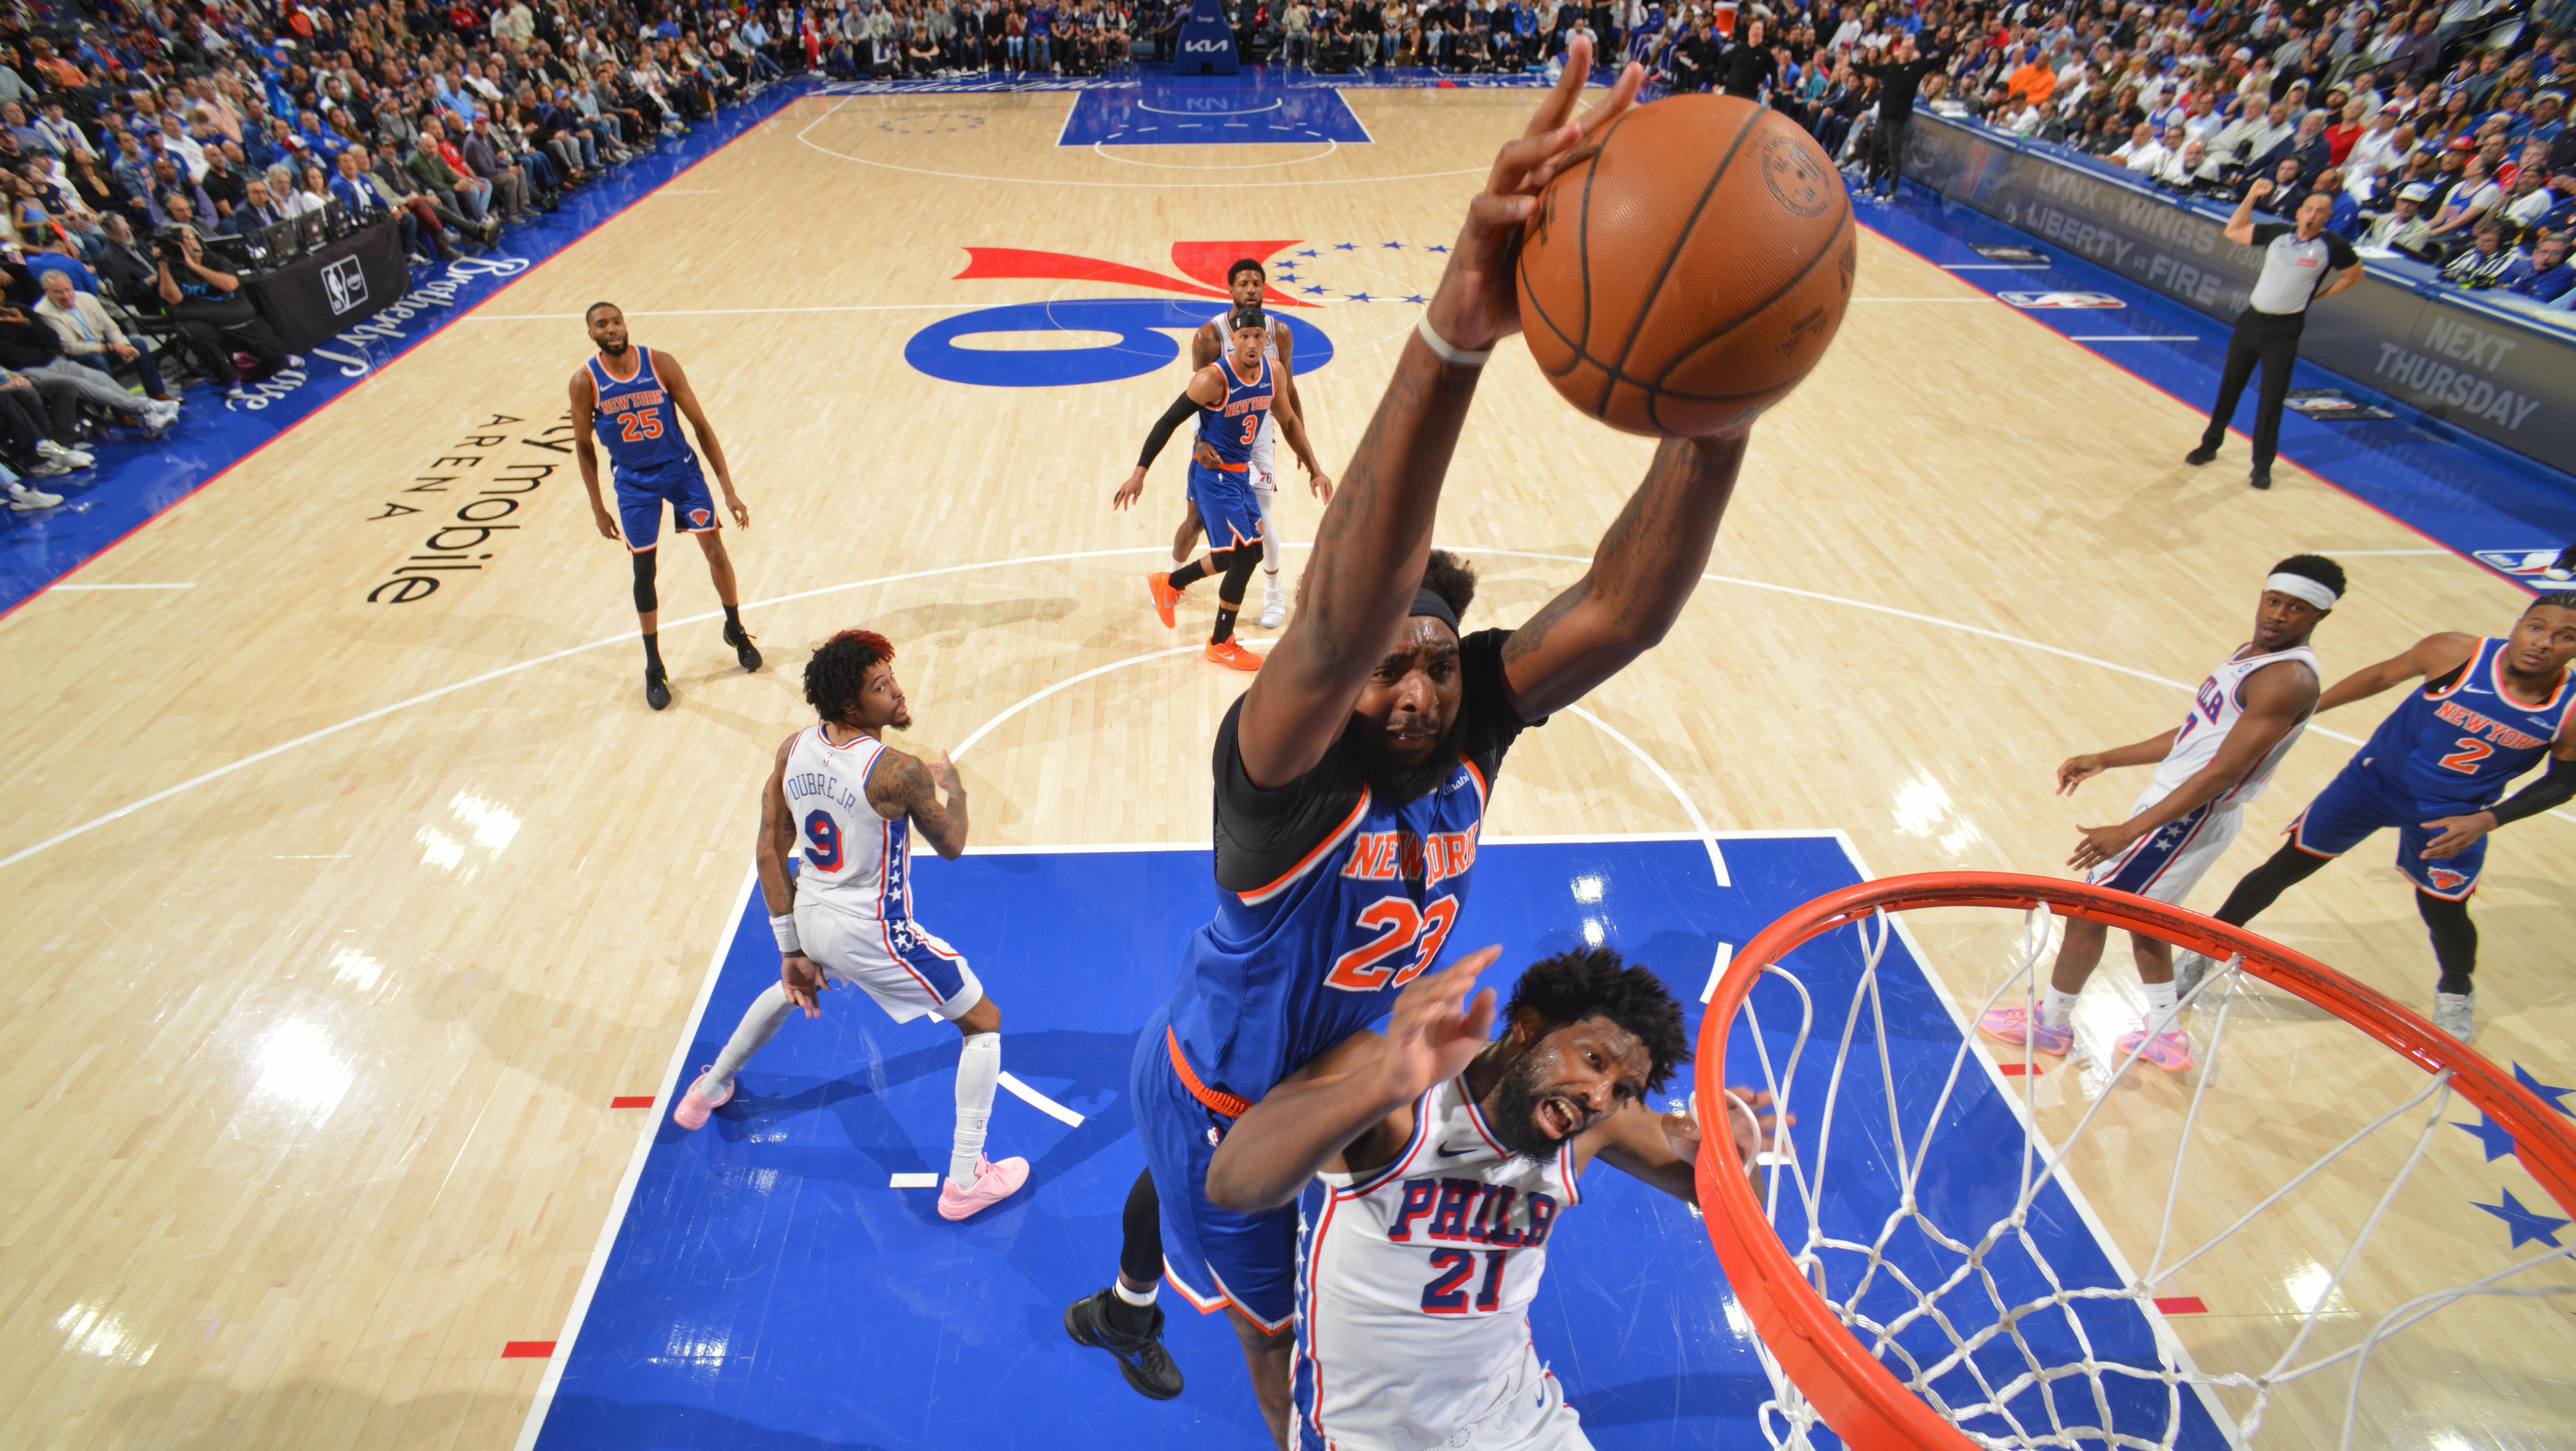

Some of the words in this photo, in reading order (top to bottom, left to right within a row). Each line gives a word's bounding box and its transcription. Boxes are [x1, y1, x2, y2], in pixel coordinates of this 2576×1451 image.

[2037, 165, 2102, 209] LYNX
[2119, 194, 2214, 255] WINGS
[2025, 201, 2134, 265] LIBERTY
[2146, 254, 2222, 307] FIRE
[2424, 316, 2518, 372] NEXT
[601, 396, 629, 415] NEW
[630, 390, 664, 408] YORK
[1225, 400, 1249, 417] NEW
[1250, 396, 1272, 412] YORK
[2375, 341, 2541, 430] THURSDAY
[617, 408, 664, 443] 25
[1240, 414, 1258, 445] 3
[367, 413, 526, 521] ARENA
[1260, 471, 1272, 484] 76
[367, 464, 560, 603] mobile
[2176, 712, 2198, 745] 7
[2433, 700, 2493, 734] NEW
[2484, 721, 2549, 750] YORK
[2437, 737, 2495, 775] 2
[788, 773, 837, 800] OUBRE
[805, 809, 843, 873] 9
[1340, 829, 1425, 882] NEW
[1324, 894, 1459, 992] 23
[1388, 1177, 1557, 1248] PHILA
[1420, 1247, 1507, 1314] 21
